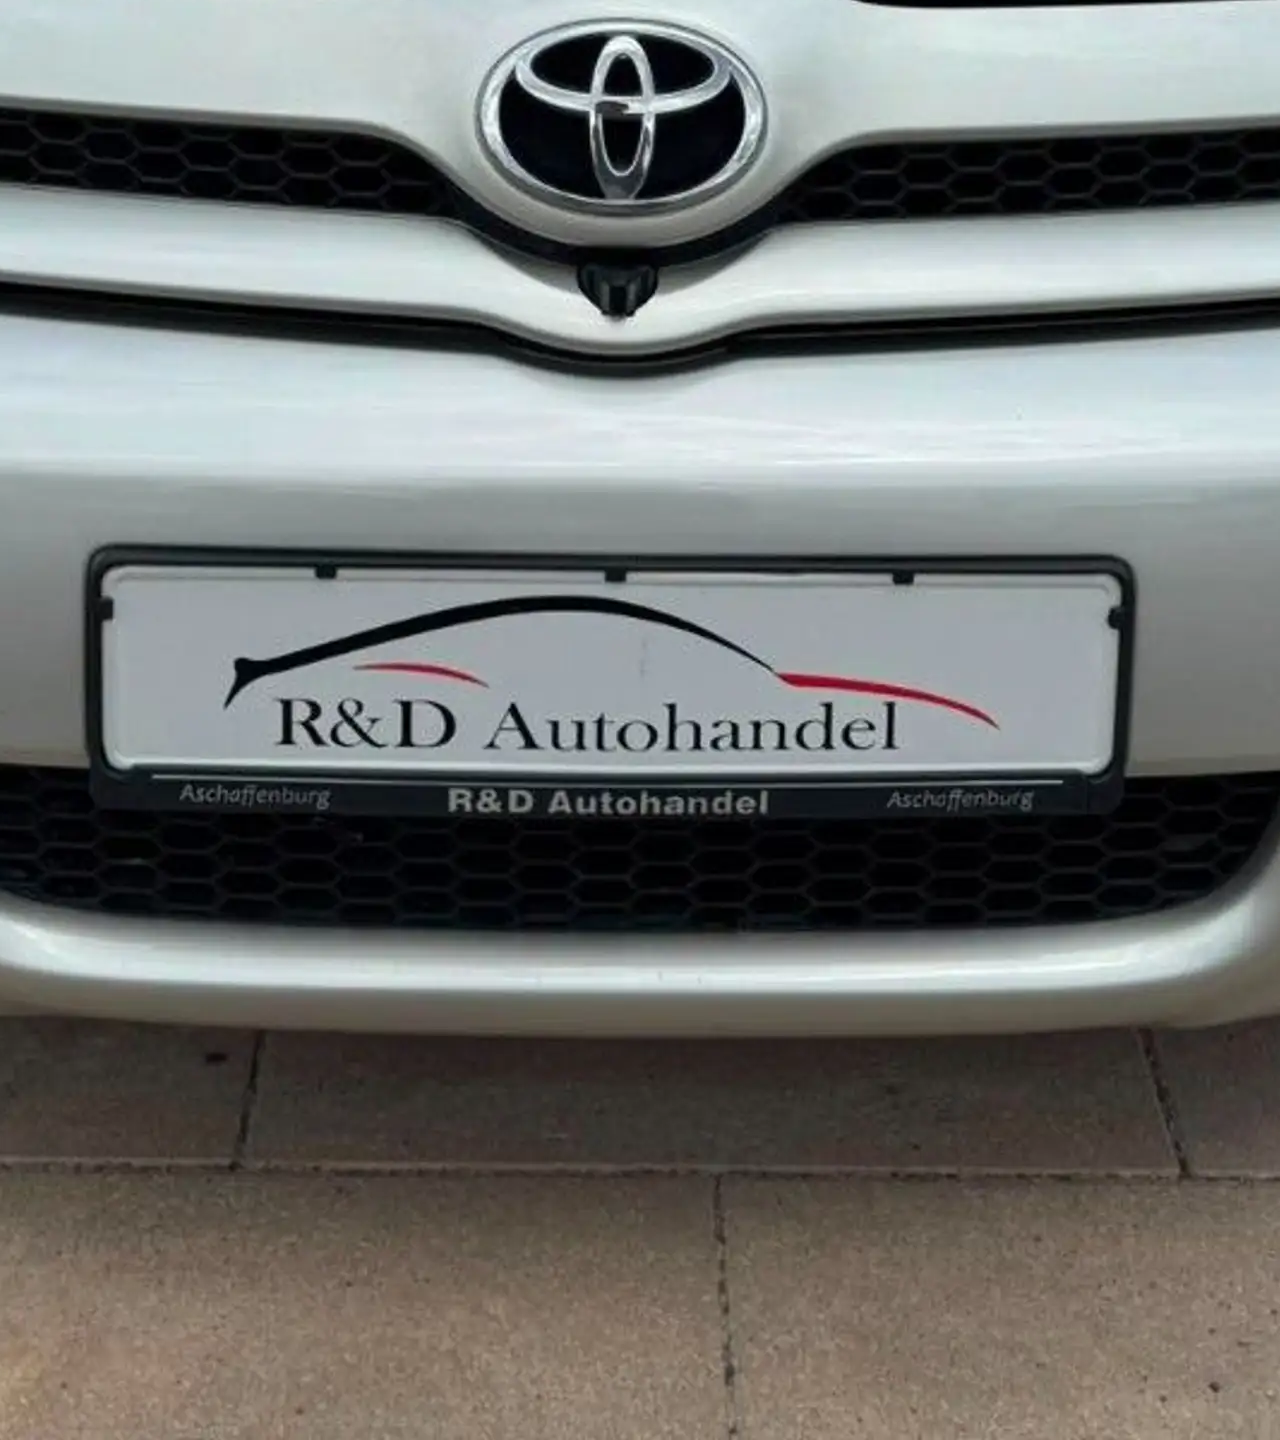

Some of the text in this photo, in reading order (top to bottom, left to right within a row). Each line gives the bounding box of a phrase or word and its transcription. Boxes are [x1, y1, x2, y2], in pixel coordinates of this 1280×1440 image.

[274, 696, 900, 752] R&D Autohandel
[179, 782, 332, 810] Aschaffenburg
[447, 787, 769, 816] R&D Autohandel
[886, 788, 1036, 811] Aschaffenburg
